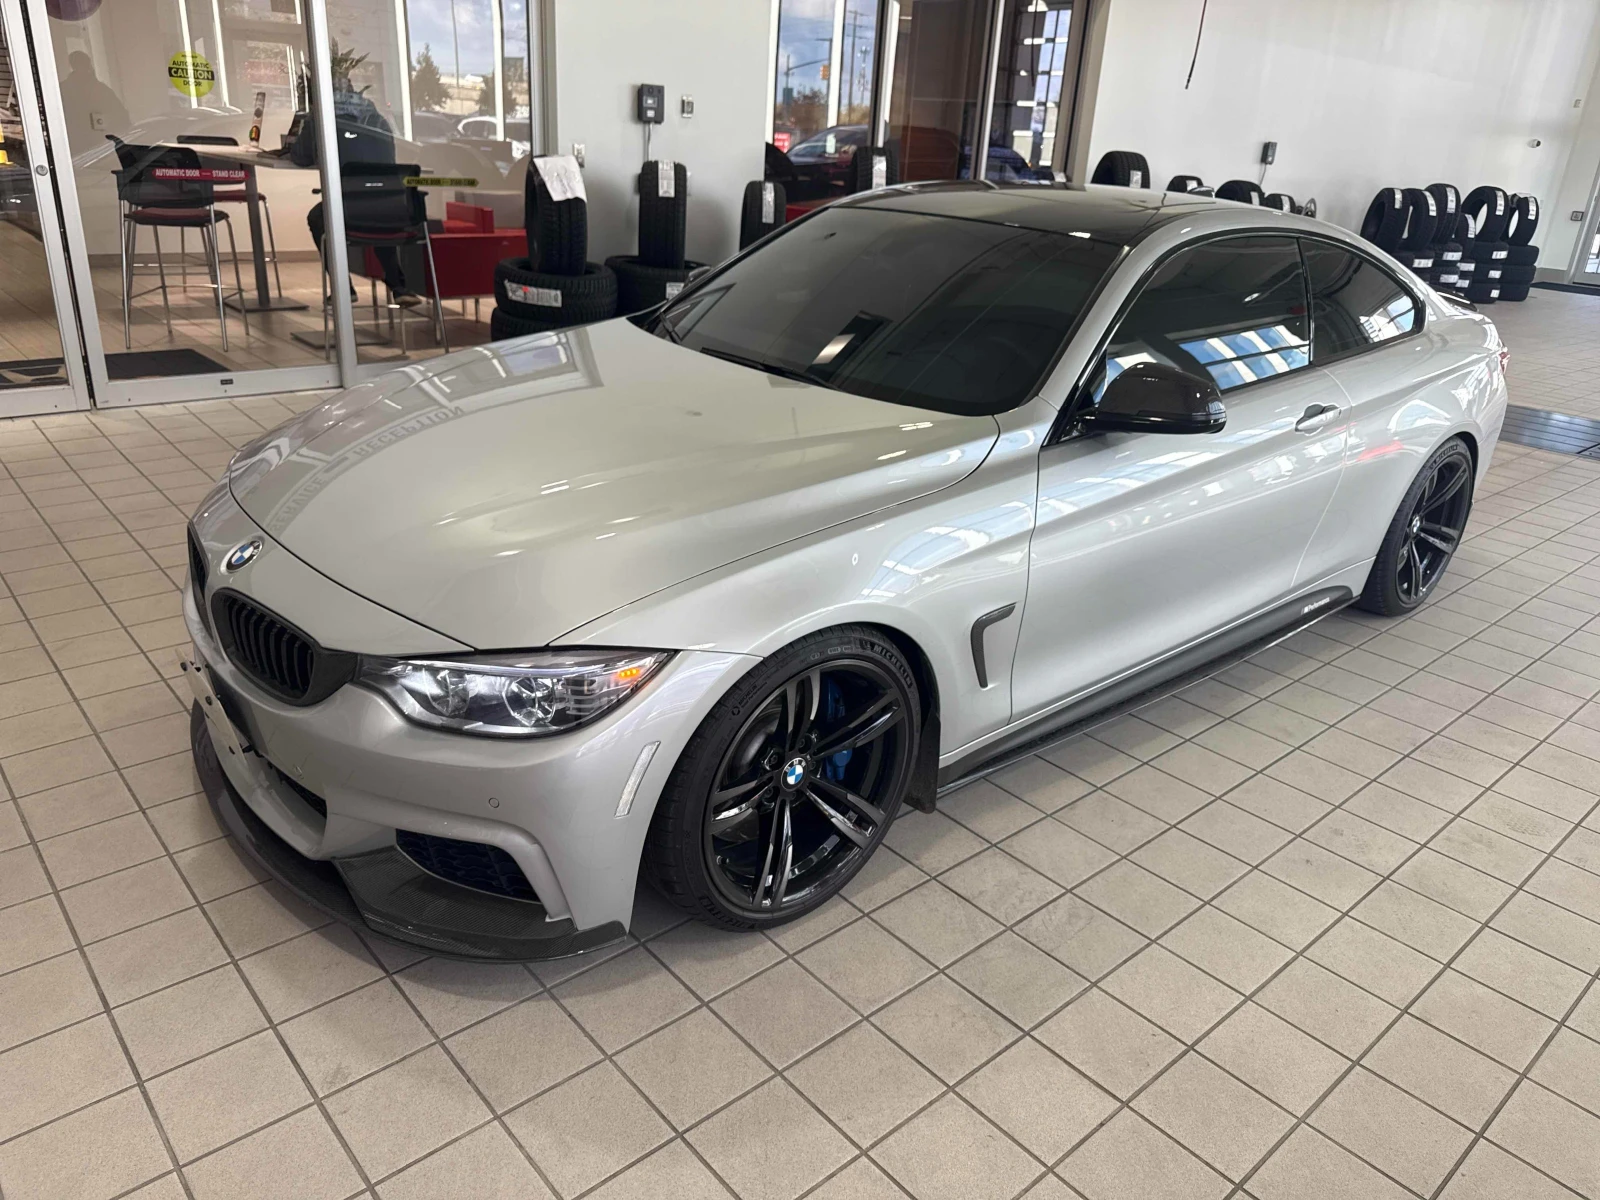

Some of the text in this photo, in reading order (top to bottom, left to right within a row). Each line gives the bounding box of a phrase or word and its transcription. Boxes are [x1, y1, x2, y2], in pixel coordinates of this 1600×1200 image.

[172, 60, 209, 69] AUTOMATIC
[171, 68, 212, 80] CAUTION
[183, 79, 202, 87] DOOR
[155, 168, 246, 178] AUTOMATIC DOOR STAND CLEAR
[873, 644, 914, 689] MICHELIN
